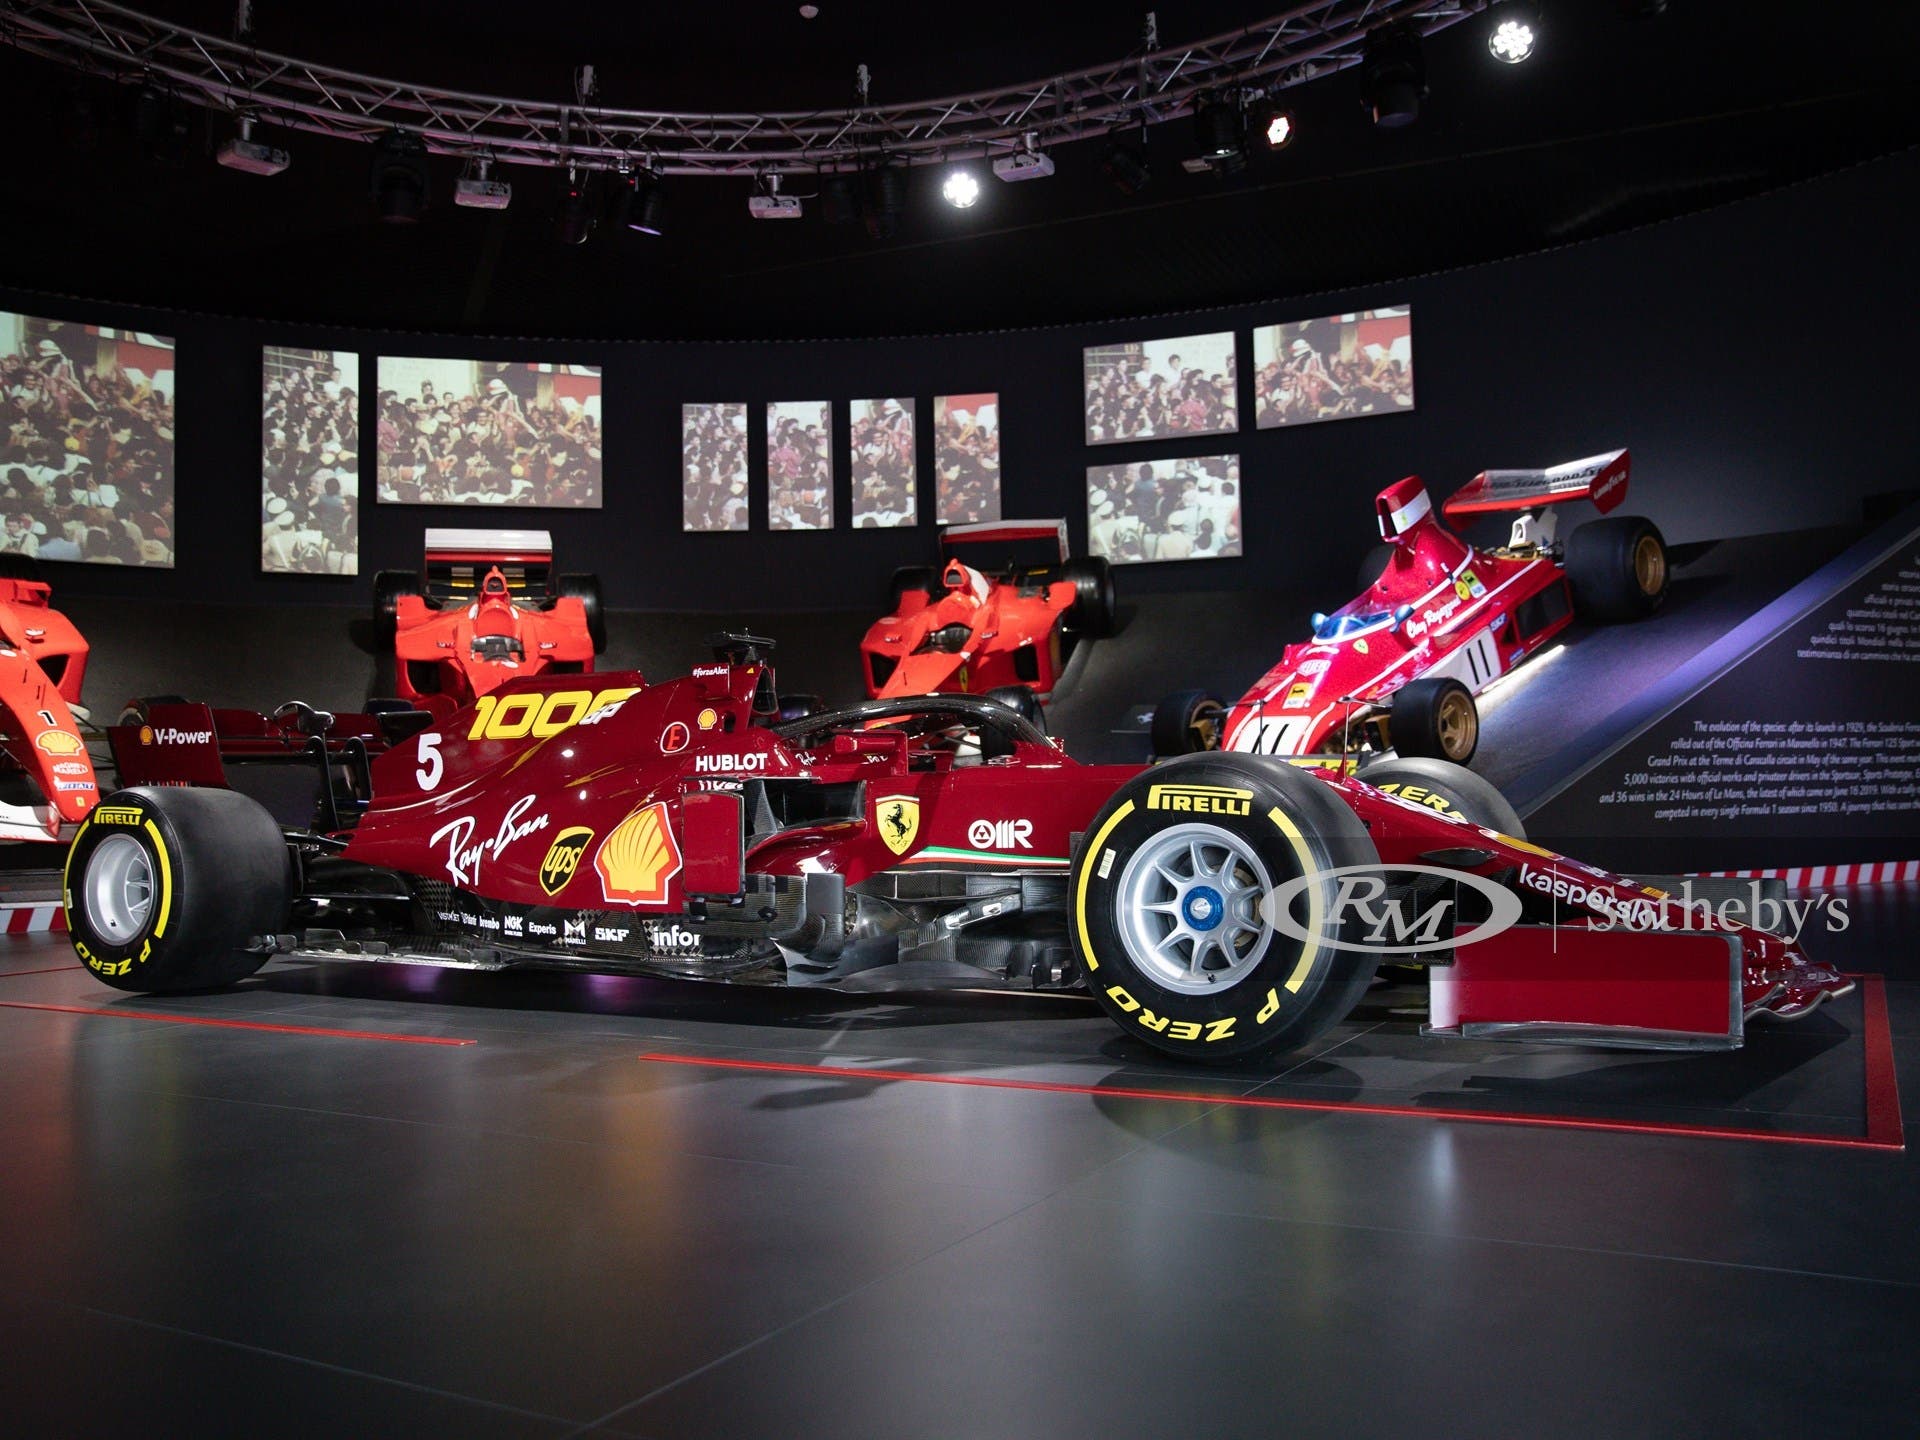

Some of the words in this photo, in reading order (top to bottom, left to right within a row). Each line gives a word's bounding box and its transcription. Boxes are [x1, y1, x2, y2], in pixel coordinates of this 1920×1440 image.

[1465, 639, 1492, 685] 11
[37, 710, 58, 726] 1
[154, 728, 212, 745] V-Power
[1694, 721, 1708, 731] The
[1708, 721, 1740, 732] evolution
[1787, 721, 1805, 734] after
[1814, 722, 1836, 732] launch
[1251, 724, 1290, 755] 11
[1671, 738, 1692, 749] rolled
[1726, 737, 1754, 750] Officina
[1755, 738, 1778, 748] Ferrari
[1787, 738, 1821, 748] Maranello
[415, 732, 444, 791] 5
[695, 753, 768, 772] HUBLOT
[1647, 755, 1672, 767] Grand
[1673, 755, 1688, 766] Prix
[1711, 754, 1734, 765] Terme
[1744, 754, 1776, 765] Caracalla
[1776, 755, 1797, 764] circuit
[1806, 755, 1821, 767] May
[1624, 773, 1648, 786] 5,000
[1649, 773, 1679, 784] victories
[1680, 772, 1696, 783] with
[1696, 771, 1721, 784] official
[1722, 771, 1742, 782] works
[1743, 771, 1757, 781] and
[1757, 773, 1787, 784] privateer
[1788, 770, 1810, 781] drivers
[1147, 784, 1254, 816] PIRELLI
[1599, 792, 1615, 803] and
[1628, 794, 1646, 802] wins
[1655, 790, 1668, 801] the
[1681, 790, 1704, 800] Hours
[94, 806, 144, 826] PIRELLI
[1654, 806, 1690, 821] competed
[1700, 808, 1719, 819] every
[1719, 805, 1740, 819] single
[1741, 804, 1771, 814] Formula
[544, 846, 583, 885] ups
[1518, 863, 1670, 930] kaspersky
[479, 915, 500, 930] brembo
[504, 915, 524, 931] NGK
[528, 921, 557, 936] Experis
[594, 927, 630, 943] SKF
[652, 925, 701, 947] infor
[75, 941, 134, 976] ZERO
[1105, 985, 1238, 1042] ZERO
[1256, 987, 1281, 1025] P
